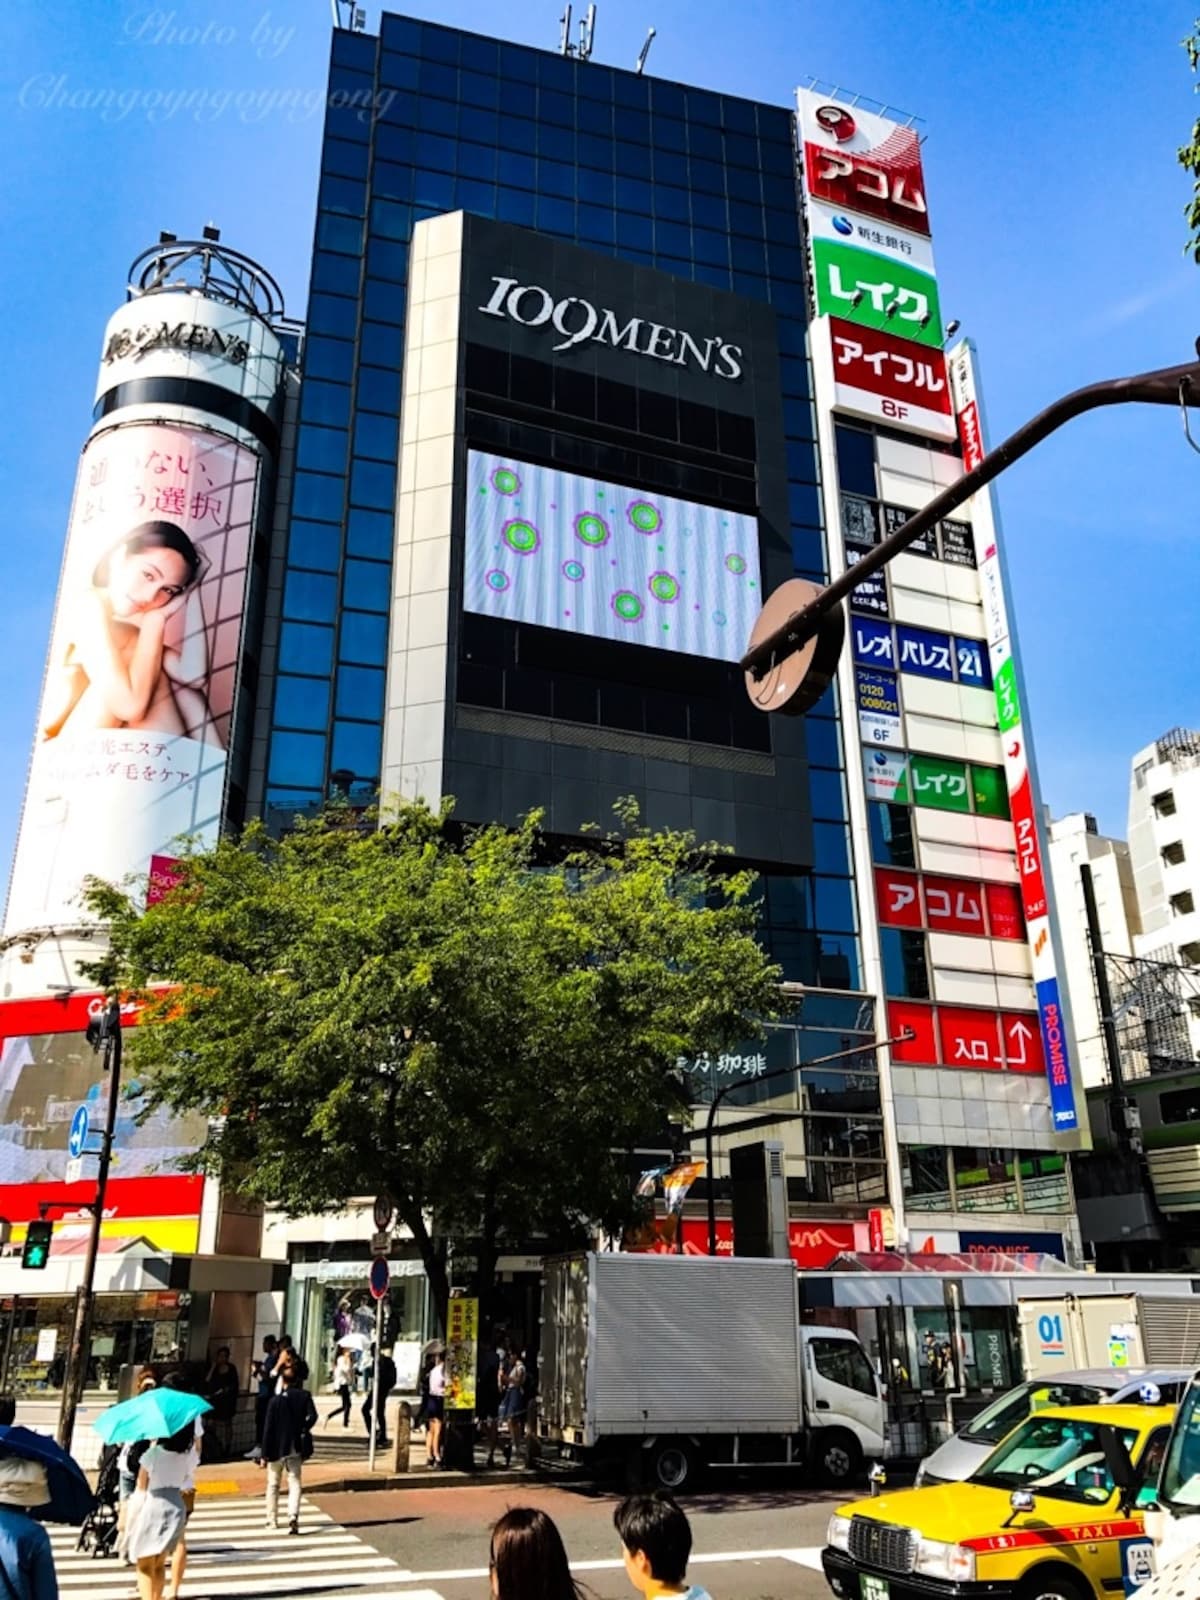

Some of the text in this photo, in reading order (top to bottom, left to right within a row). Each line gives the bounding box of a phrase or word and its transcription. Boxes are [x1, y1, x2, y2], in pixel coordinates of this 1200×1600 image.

[817, 150, 927, 213] アコム
[857, 225, 913, 256] 新生銀行
[828, 264, 929, 322] レイク
[833, 336, 945, 392] アイフル
[881, 399, 909, 420] 8F
[860, 683, 884, 697] 0120
[999, 674, 1015, 721] レイク
[873, 728, 889, 741] 6F
[911, 767, 967, 797] レイク
[1018, 817, 1038, 875] アコム
[888, 883, 981, 921] アコム
[954, 1037, 989, 1061] 入口
[1044, 1004, 1068, 1085] PROMISE
[1038, 1315, 1063, 1342] 01
[987, 1334, 1004, 1387] PROMIS
[1070, 1526, 1112, 1540] TAXI
